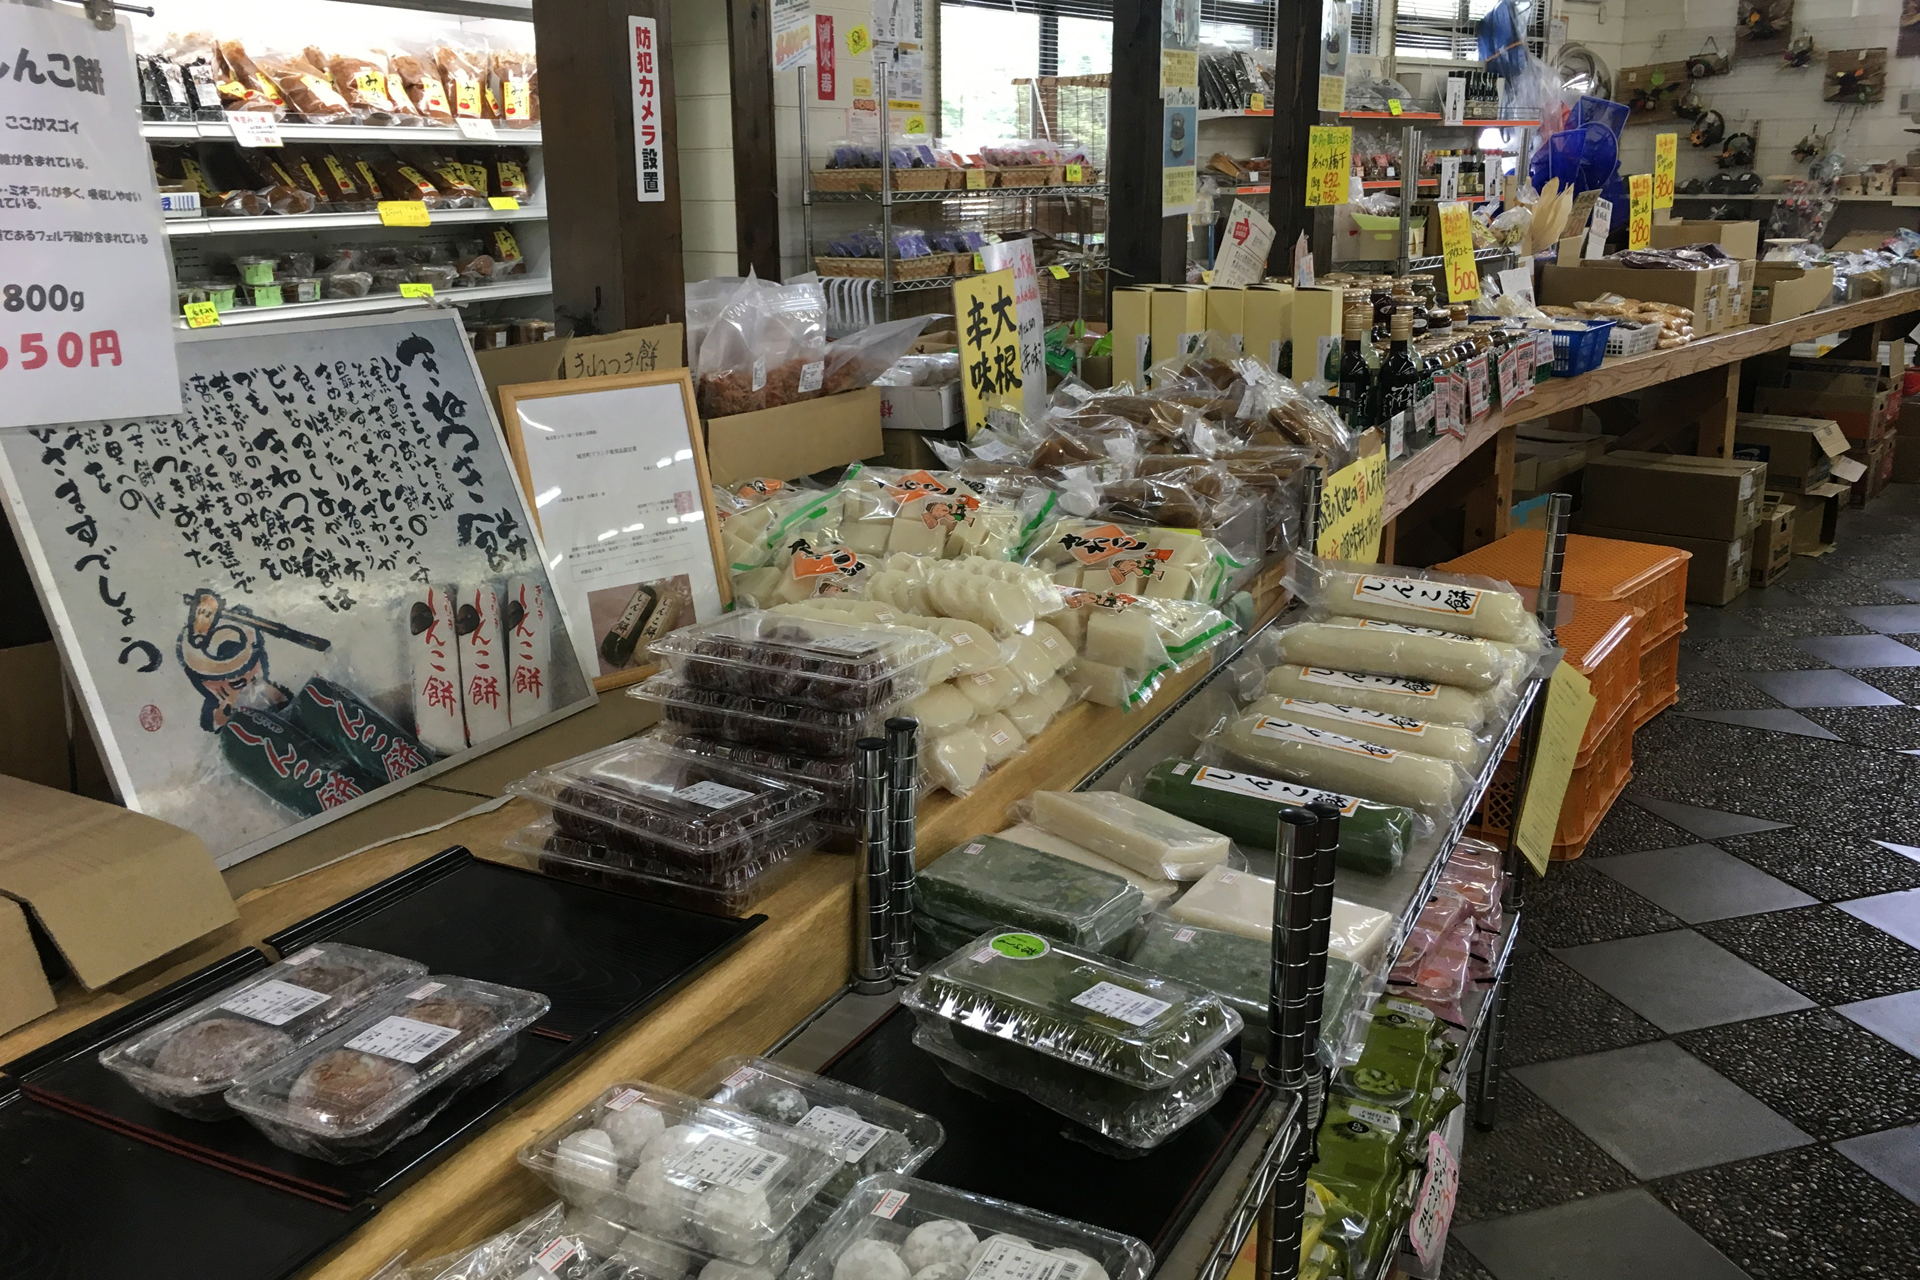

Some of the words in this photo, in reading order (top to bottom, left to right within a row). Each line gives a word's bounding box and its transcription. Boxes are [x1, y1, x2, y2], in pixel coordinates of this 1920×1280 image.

[819, 23, 833, 93] 消火器
[5, 115, 79, 134] ここがスゴイ
[635, 26, 659, 193] 防犯カメラ設置
[0, 229, 149, 245] であるフェルラ酸が含まれている
[3, 284, 84, 312] 800g
[574, 338, 660, 378] きねつき餅
[1363, 581, 1477, 613] しんこ餅
[422, 586, 457, 718] しんこ餅
[468, 588, 500, 710] しんこ餅
[512, 583, 543, 699] しんこ餅
[1309, 669, 1433, 694] しんこ餅
[1265, 720, 1391, 756] しんこ餅
